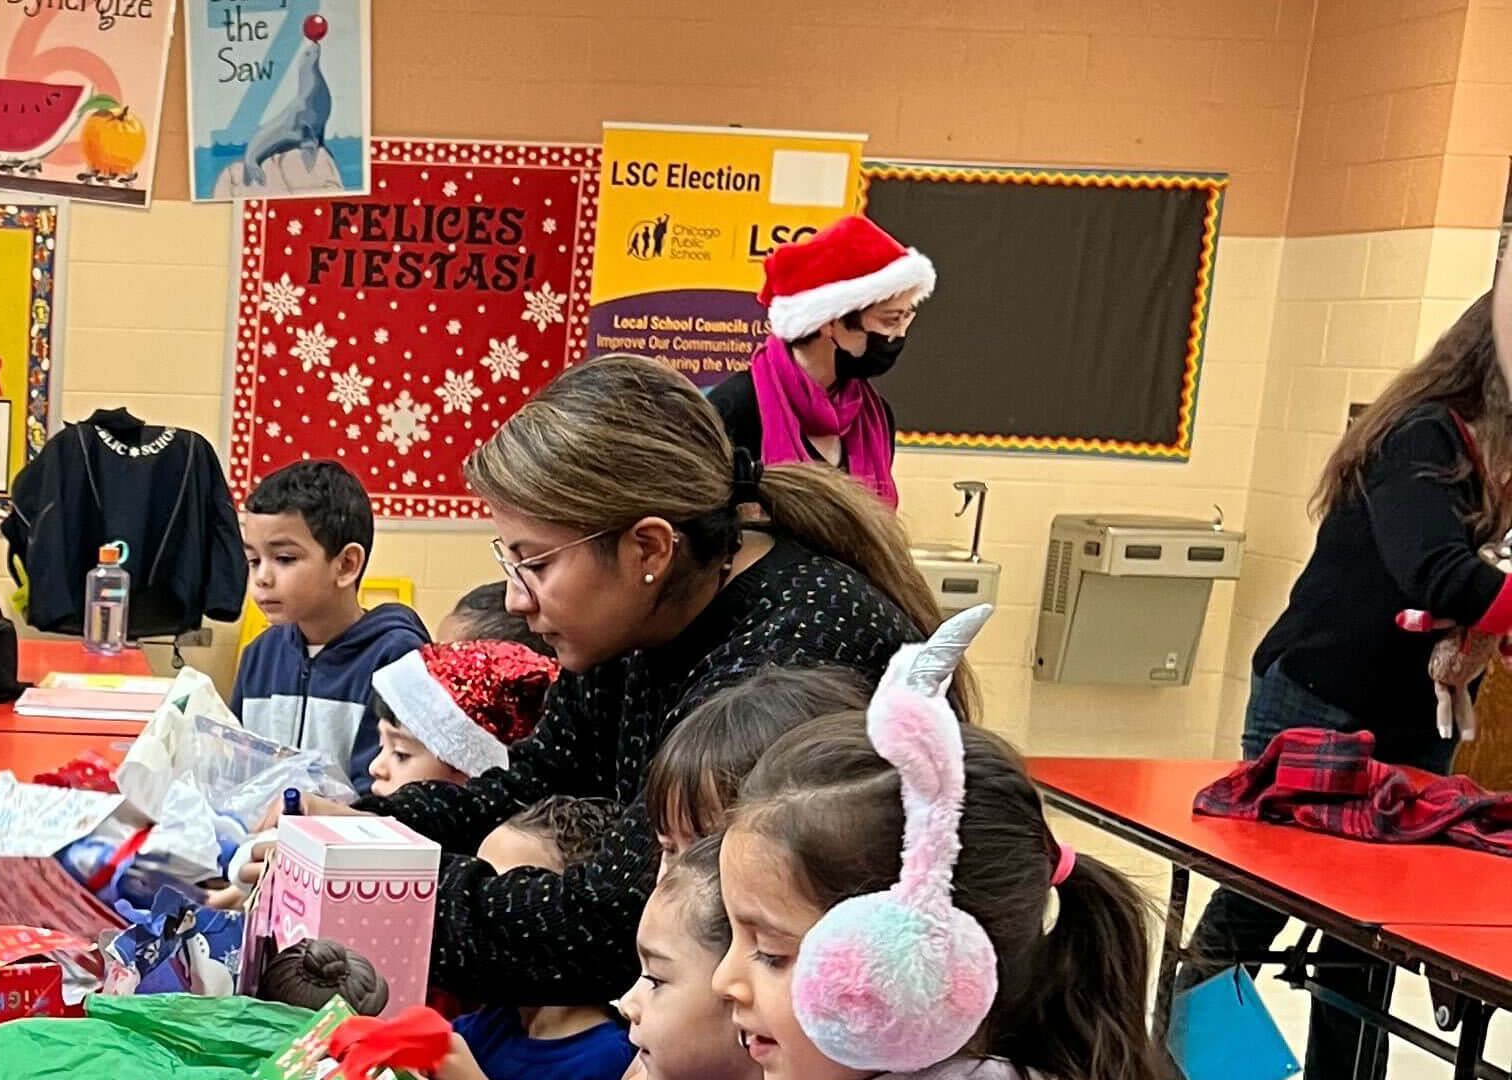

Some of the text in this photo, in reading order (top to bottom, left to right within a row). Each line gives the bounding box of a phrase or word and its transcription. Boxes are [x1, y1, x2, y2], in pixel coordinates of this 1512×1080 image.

[223, 8, 269, 42] the
[217, 47, 274, 83] Saw
[612, 161, 760, 192] LSC Election
[329, 201, 525, 245] FELICES
[672, 224, 721, 239] Chicago
[671, 236, 705, 250] Public
[670, 249, 712, 262] Schools
[308, 246, 536, 293] FIESTAS!
[613, 315, 648, 330] Local
[651, 316, 693, 333] School
[695, 318, 749, 334] Councils
[596, 333, 752, 353] Improve Our Communities
[702, 358, 722, 372] the
